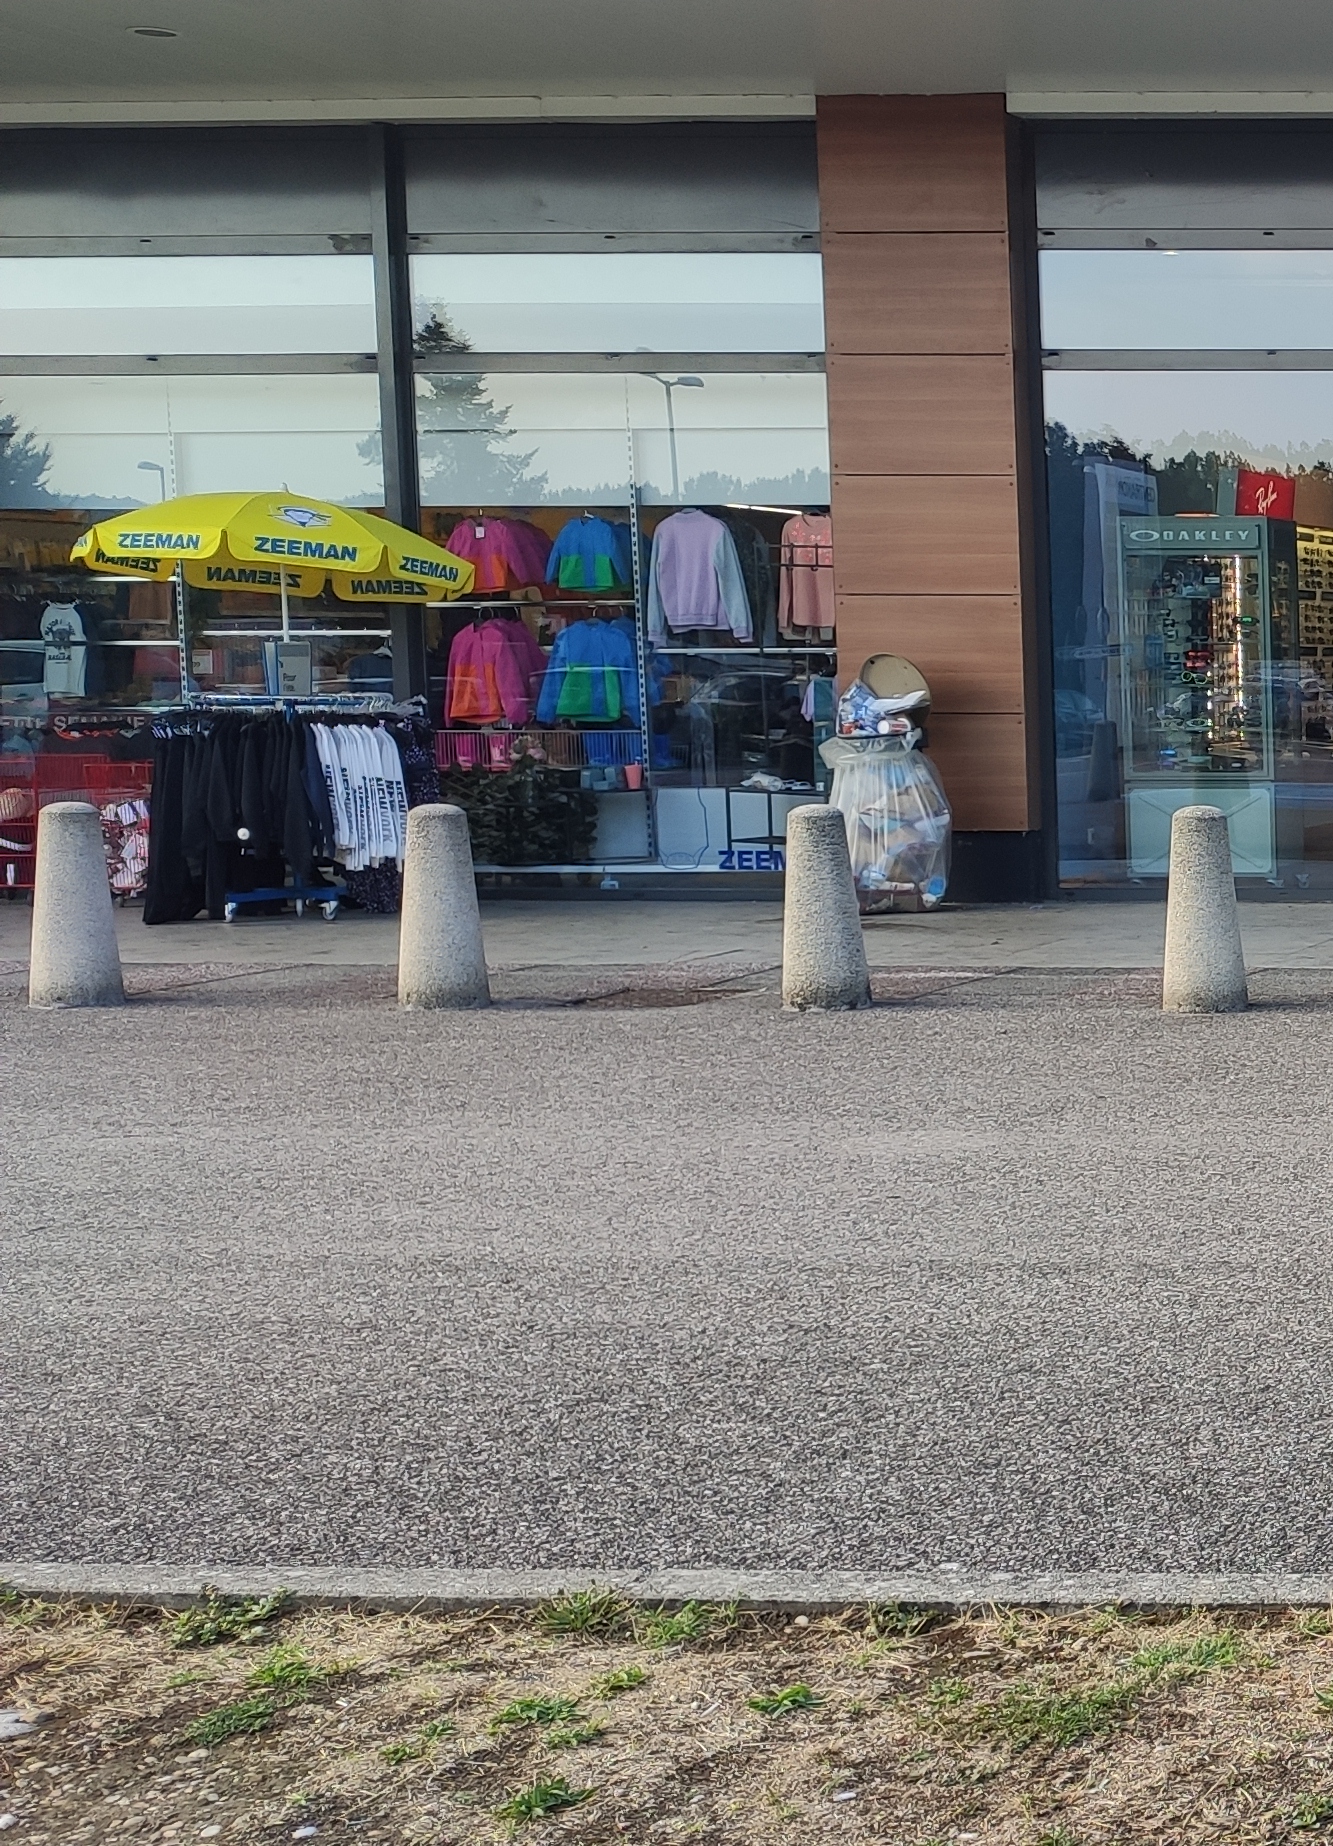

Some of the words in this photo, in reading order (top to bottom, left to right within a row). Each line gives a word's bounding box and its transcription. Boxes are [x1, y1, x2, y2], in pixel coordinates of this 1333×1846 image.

[117, 532, 200, 551] ZEEMAN
[1163, 530, 1249, 541] OAKLEY
[254, 536, 359, 562] ZEEMAN
[400, 555, 460, 583] ZEEMAN
[718, 850, 786, 870] ZEEM
